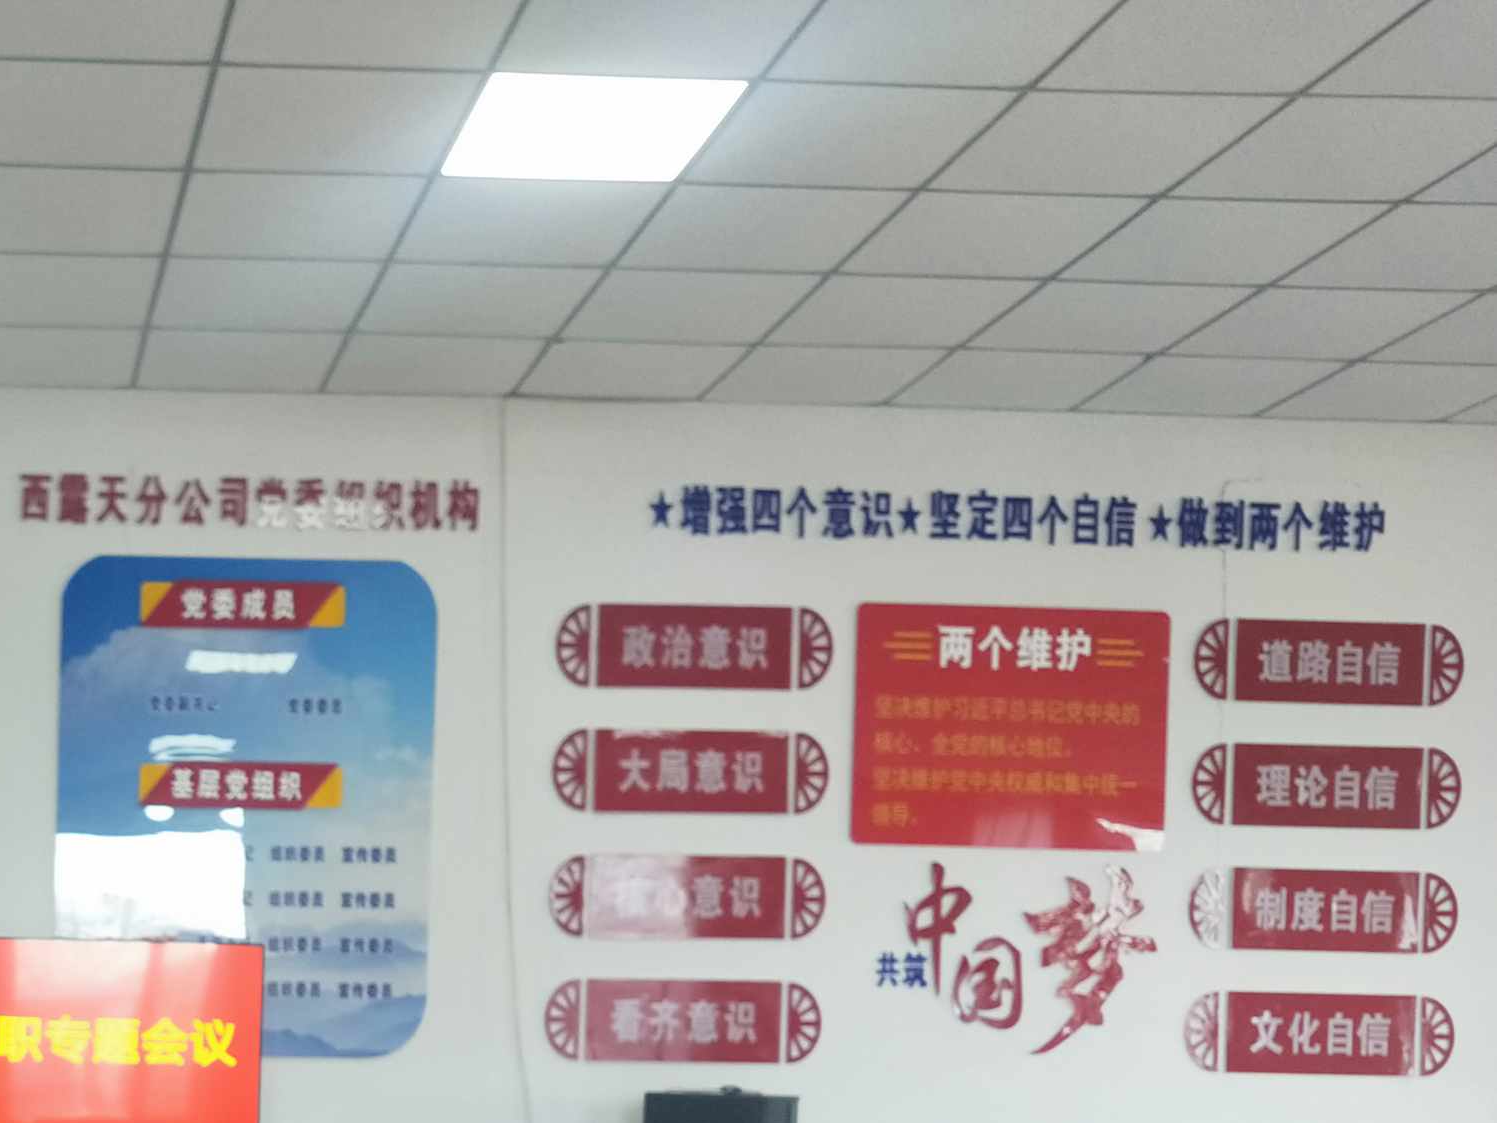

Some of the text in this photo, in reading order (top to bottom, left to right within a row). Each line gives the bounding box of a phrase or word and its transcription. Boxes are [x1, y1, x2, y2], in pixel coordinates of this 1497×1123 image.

[680, 485, 1387, 552] 增强四个意识 坚定四个自信 做到两个维护
[180, 588, 297, 621] 党委成员
[621, 625, 770, 670] 政治意识
[938, 624, 1093, 671] 两个维护
[1257, 640, 1402, 687] 道路自信
[171, 767, 303, 801] 基层党组织
[618, 750, 765, 795] 大局意识
[1256, 764, 1399, 811] 理论自信
[614, 874, 762, 919] 意识
[1253, 888, 1397, 935] 制度自信
[875, 952, 928, 989] 共筑
[902, 862, 1159, 1055] 中国梦
[610, 999, 758, 1044] 看齐意识
[1249, 1010, 1393, 1057] 文化自信
